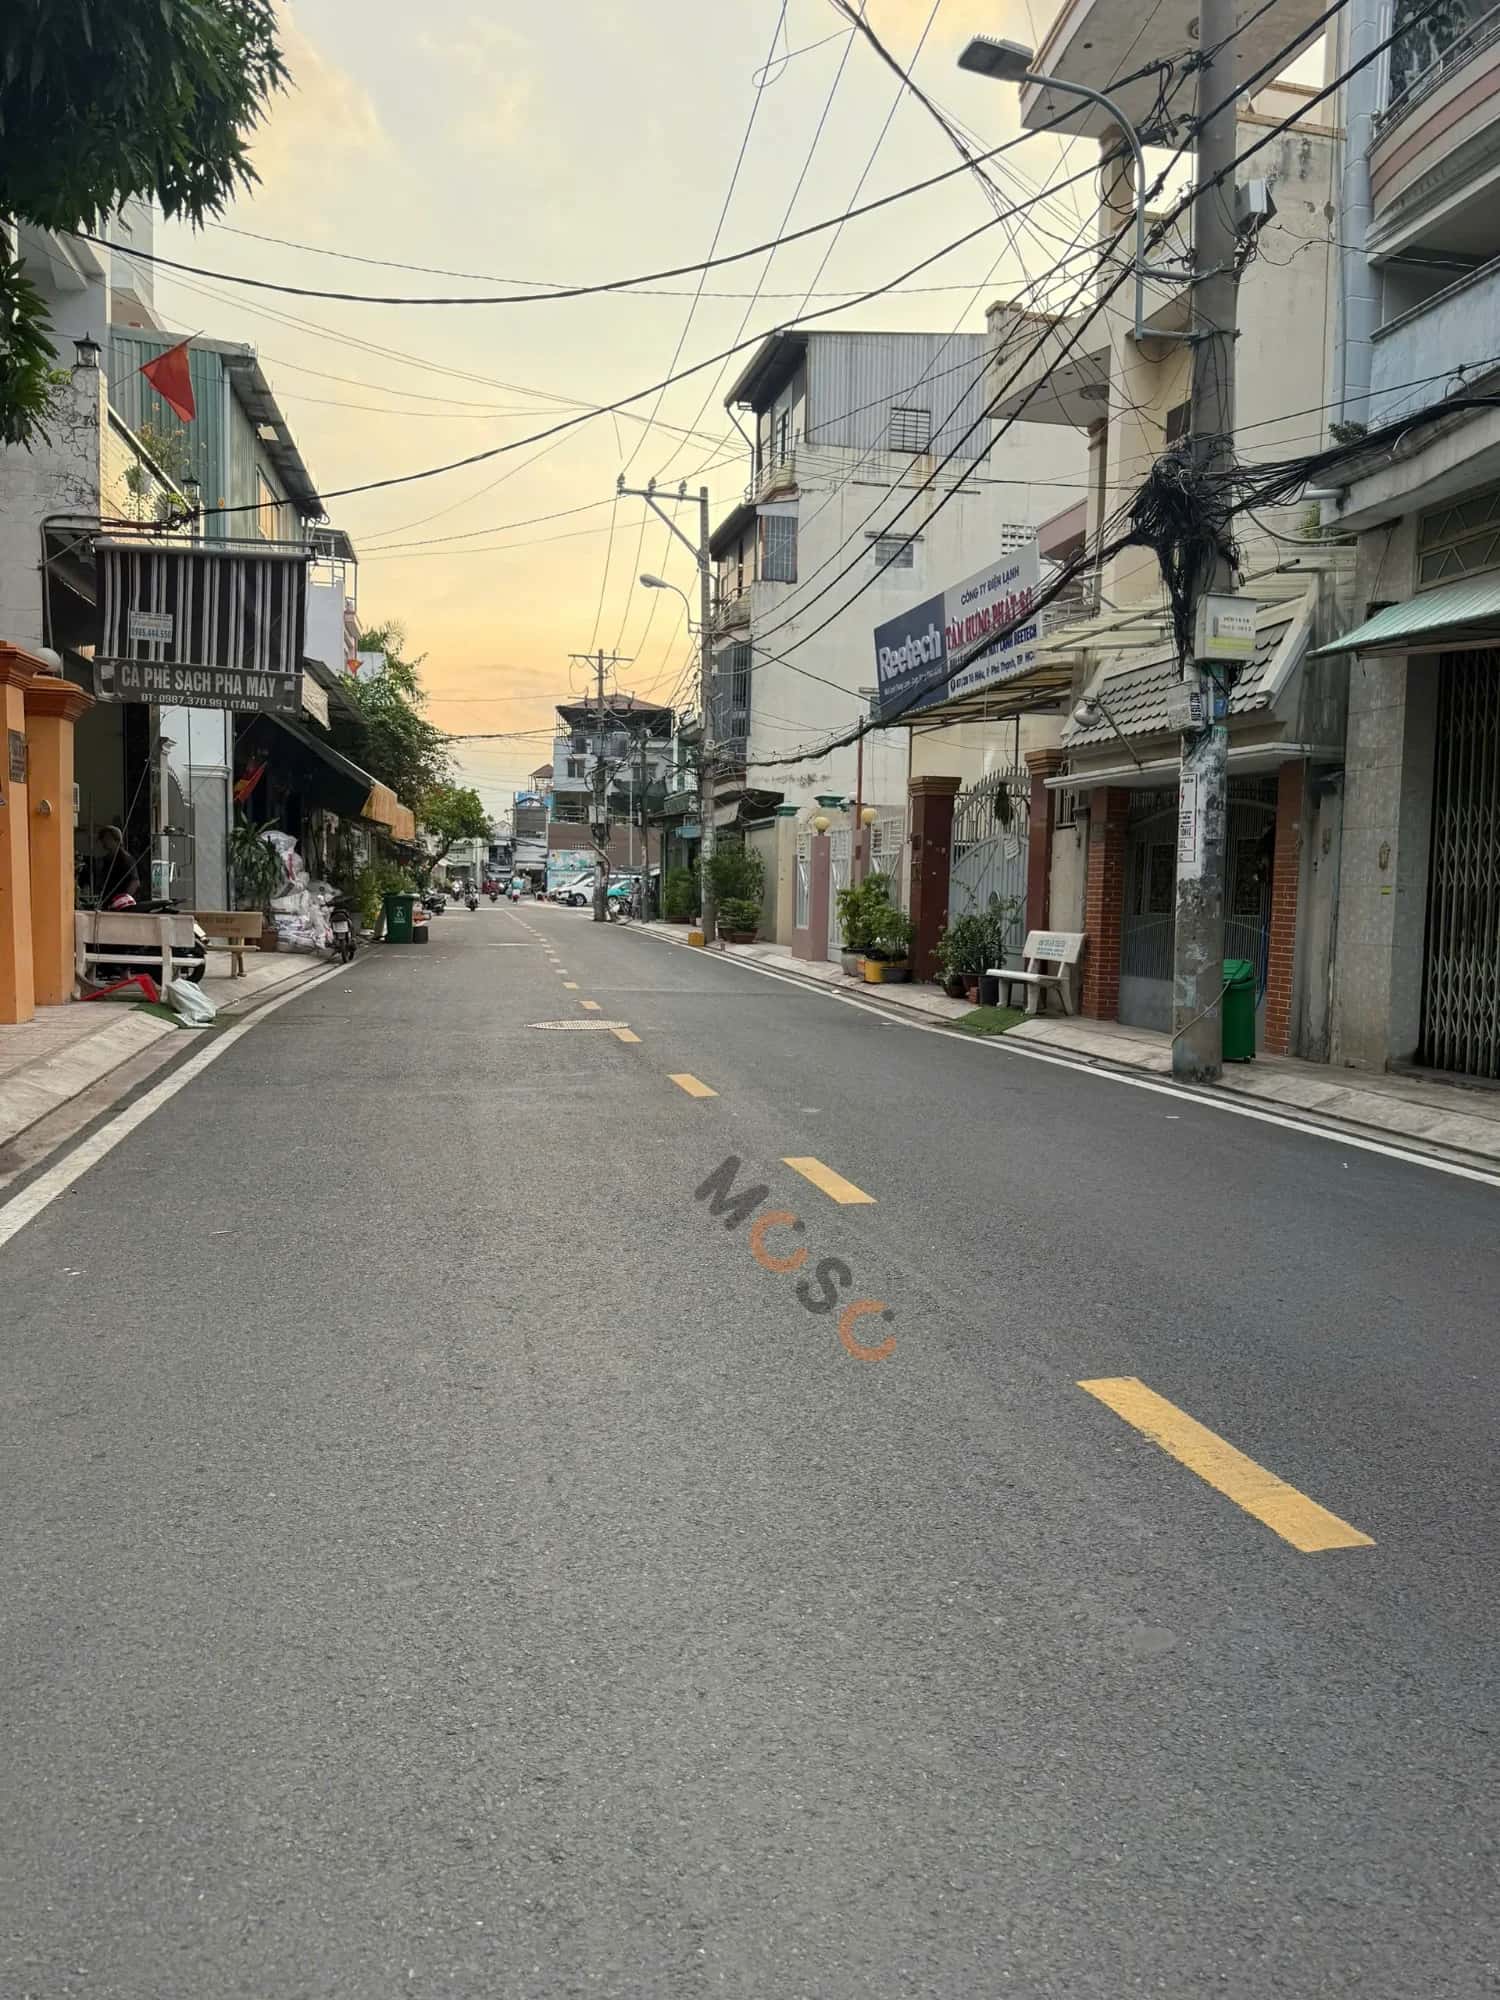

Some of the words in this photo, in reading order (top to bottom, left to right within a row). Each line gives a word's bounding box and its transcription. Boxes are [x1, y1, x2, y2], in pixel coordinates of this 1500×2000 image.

[961, 588, 979, 605] CÔNG
[980, 582, 987, 596] TY
[1003, 565, 1020, 585] LẠNH
[879, 623, 942, 682] Reetech
[121, 662, 140, 688] CÀ
[144, 664, 170, 689] PHÊ
[174, 669, 211, 696] SẠCH
[215, 672, 242, 696] PHA
[246, 673, 276, 698] MÁY
